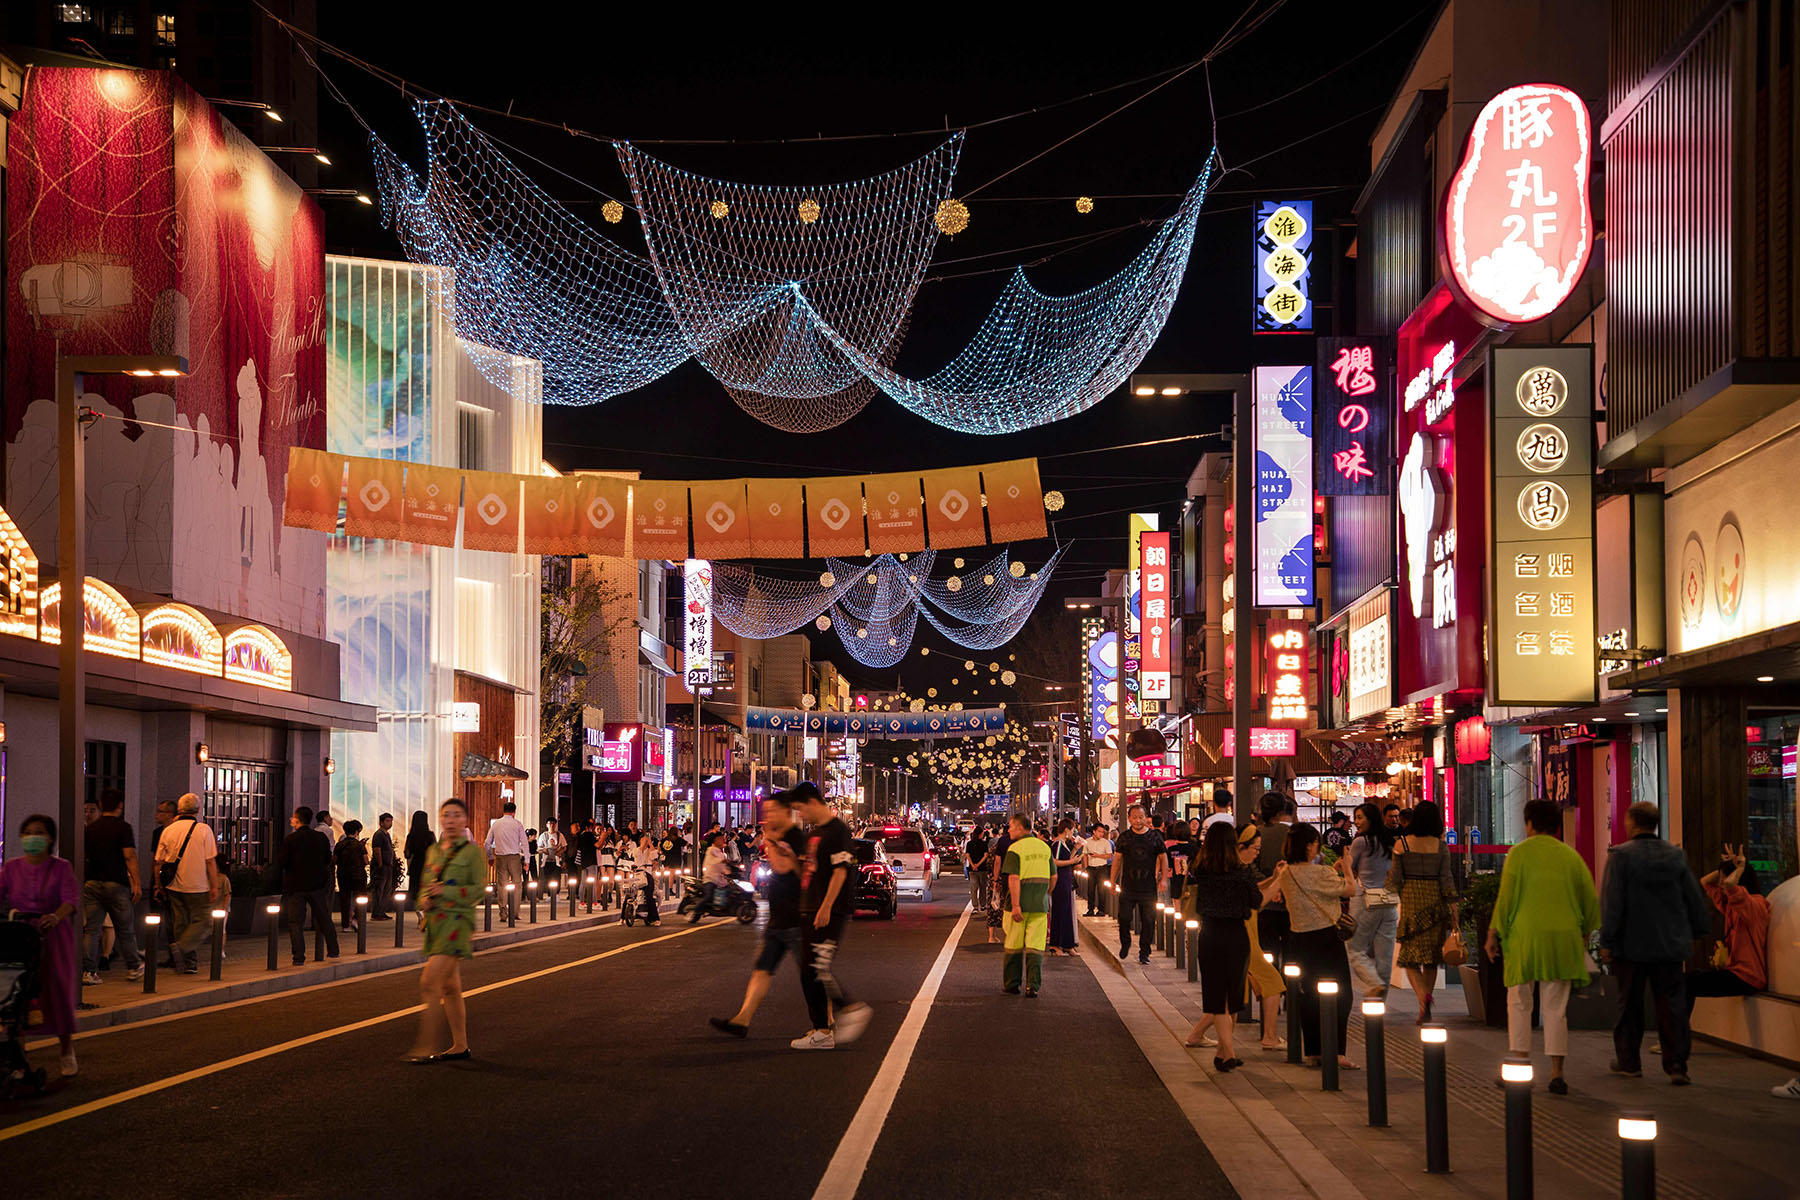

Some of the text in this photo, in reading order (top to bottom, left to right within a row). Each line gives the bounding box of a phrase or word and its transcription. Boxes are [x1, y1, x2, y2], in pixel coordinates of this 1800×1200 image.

[1503, 97, 1558, 209] 豚丸
[1501, 211, 1558, 249] 2F
[1272, 216, 1298, 312] 淮海街
[1261, 393, 1291, 402] HUAI
[1261, 407, 1284, 416] HAI
[1262, 421, 1306, 430] STREET
[1526, 371, 1564, 523] 萬旭昌
[1261, 470, 1291, 479] HUAI
[1261, 484, 1284, 493] HAI
[1262, 498, 1305, 507] STREET
[870, 507, 919, 521] 淮海街
[636, 514, 684, 527] 淮海街
[1262, 547, 1292, 556] HUAI
[1263, 562, 1284, 570] HAI
[1515, 552, 1574, 578] 名烟
[1145, 546, 1166, 619] 朝日屋
[1263, 575, 1307, 584] STREET
[1515, 592, 1575, 617] 名酒
[689, 671, 709, 684] 2F
[1147, 679, 1166, 691] 2F
